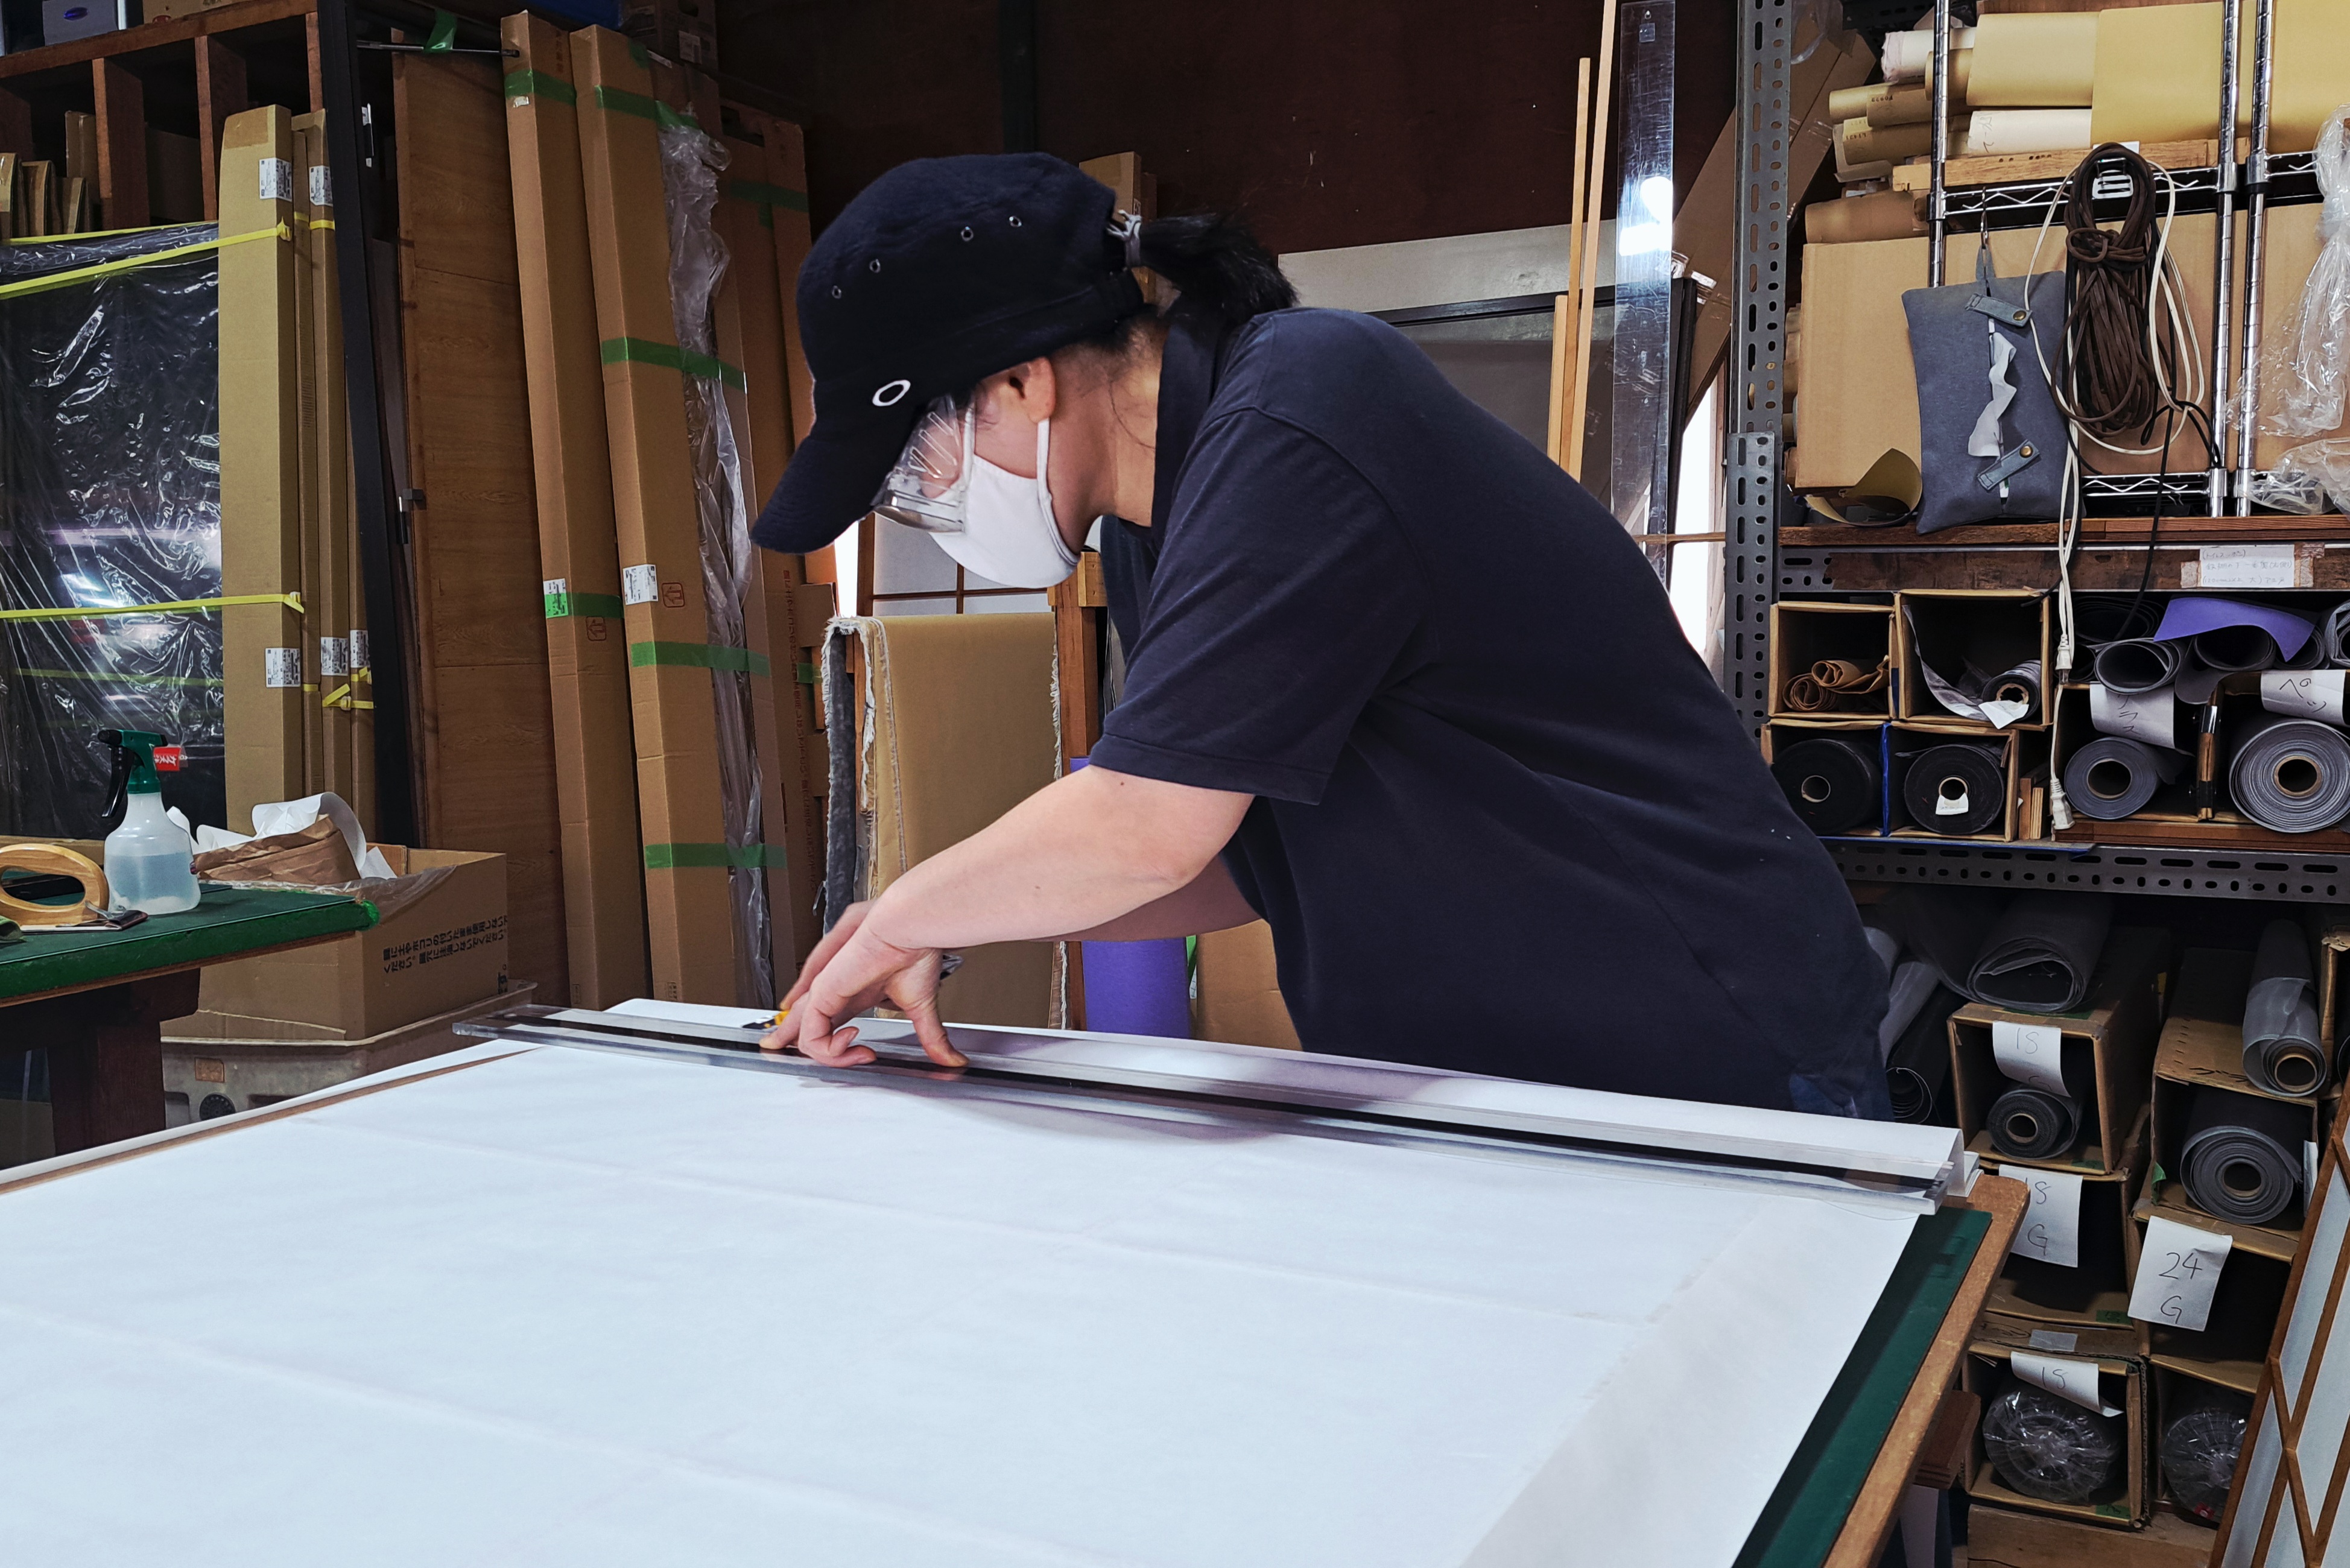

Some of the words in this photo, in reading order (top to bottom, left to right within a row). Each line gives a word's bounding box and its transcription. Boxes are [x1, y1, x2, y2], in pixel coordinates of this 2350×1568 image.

[2025, 1177, 2051, 1204] 8
[2027, 1224, 2048, 1256] G
[2158, 1252, 2203, 1280] 24
[2161, 1295, 2182, 1324] G
